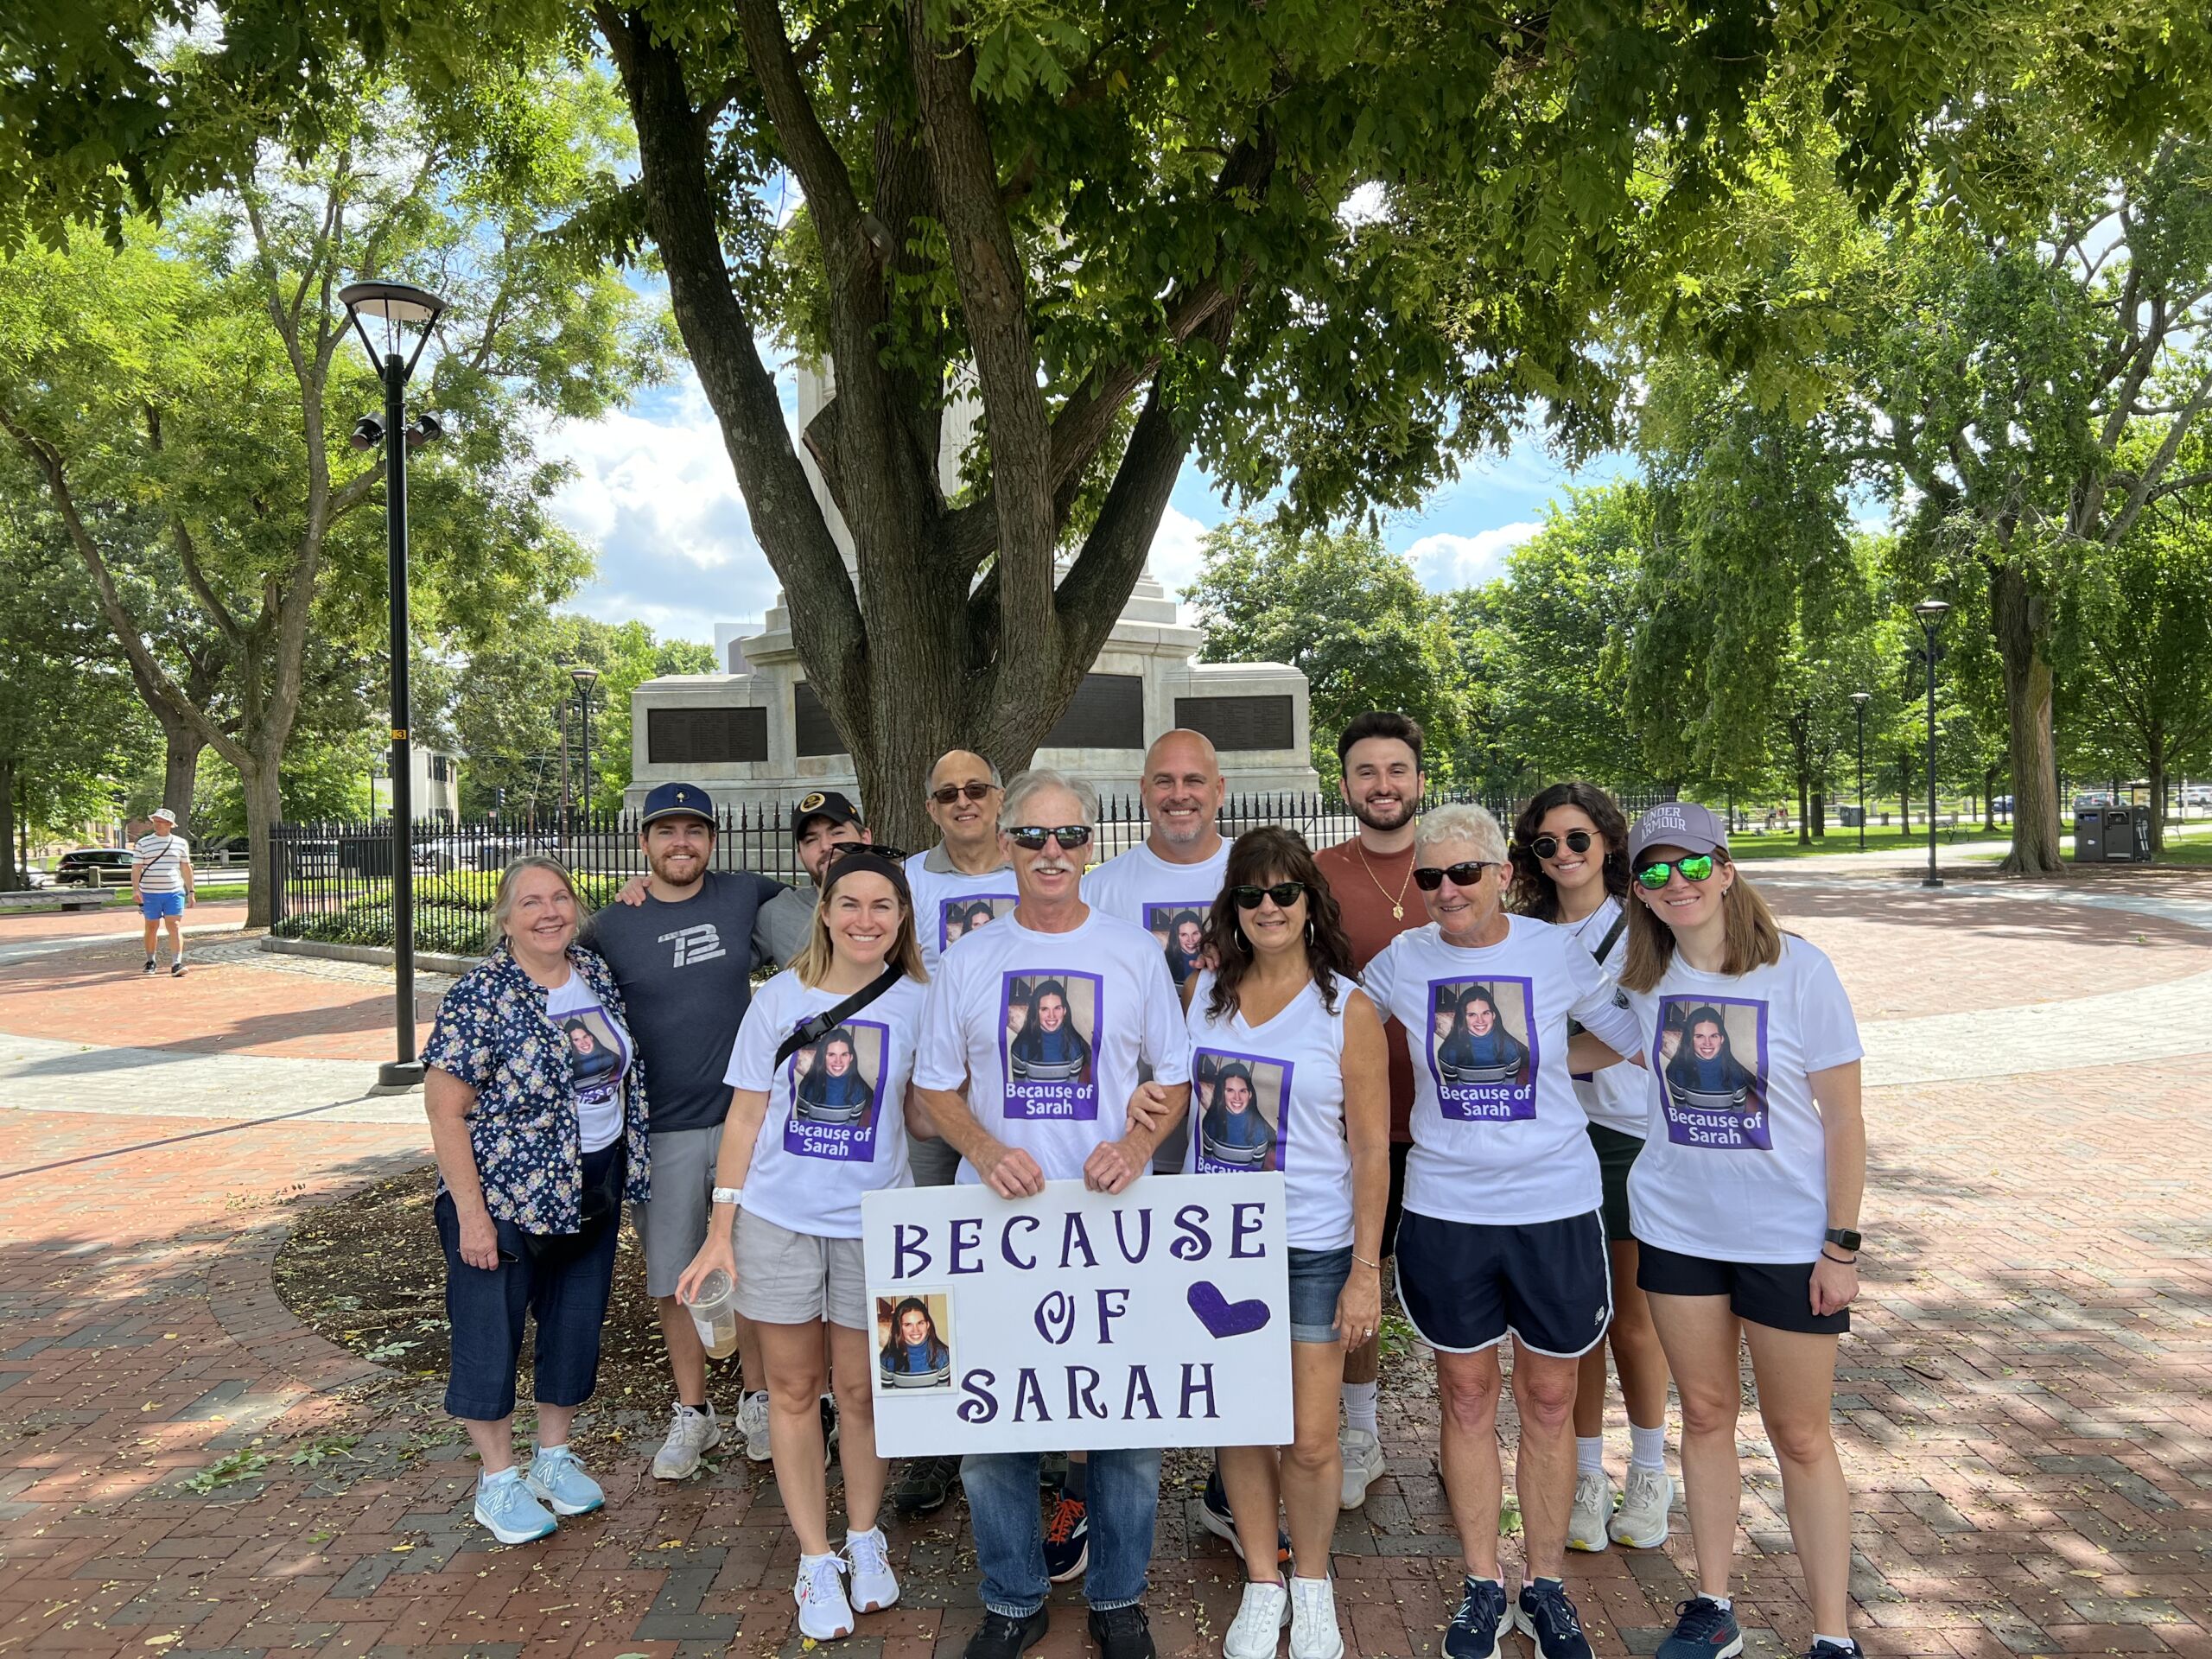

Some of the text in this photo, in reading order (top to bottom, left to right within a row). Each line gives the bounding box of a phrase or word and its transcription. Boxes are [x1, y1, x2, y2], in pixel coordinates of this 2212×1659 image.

[1643, 807, 1681, 826] UNDER
[1642, 817, 1687, 842] ARMOUR
[1006, 1083, 1093, 1099] Because of
[1440, 1084, 1531, 1101] Because of
[1026, 1099, 1072, 1115] Sarah
[1462, 1101, 1510, 1116] Sarah
[1669, 1107, 1762, 1128] Because of
[789, 1120, 872, 1141] Because of
[1688, 1127, 1741, 1144] Sarah
[803, 1138, 849, 1156] Sarah
[892, 1202, 1266, 1280] BECAUSE
[1033, 1288, 1130, 1344] OF
[956, 1363, 1221, 1424] SARAH
